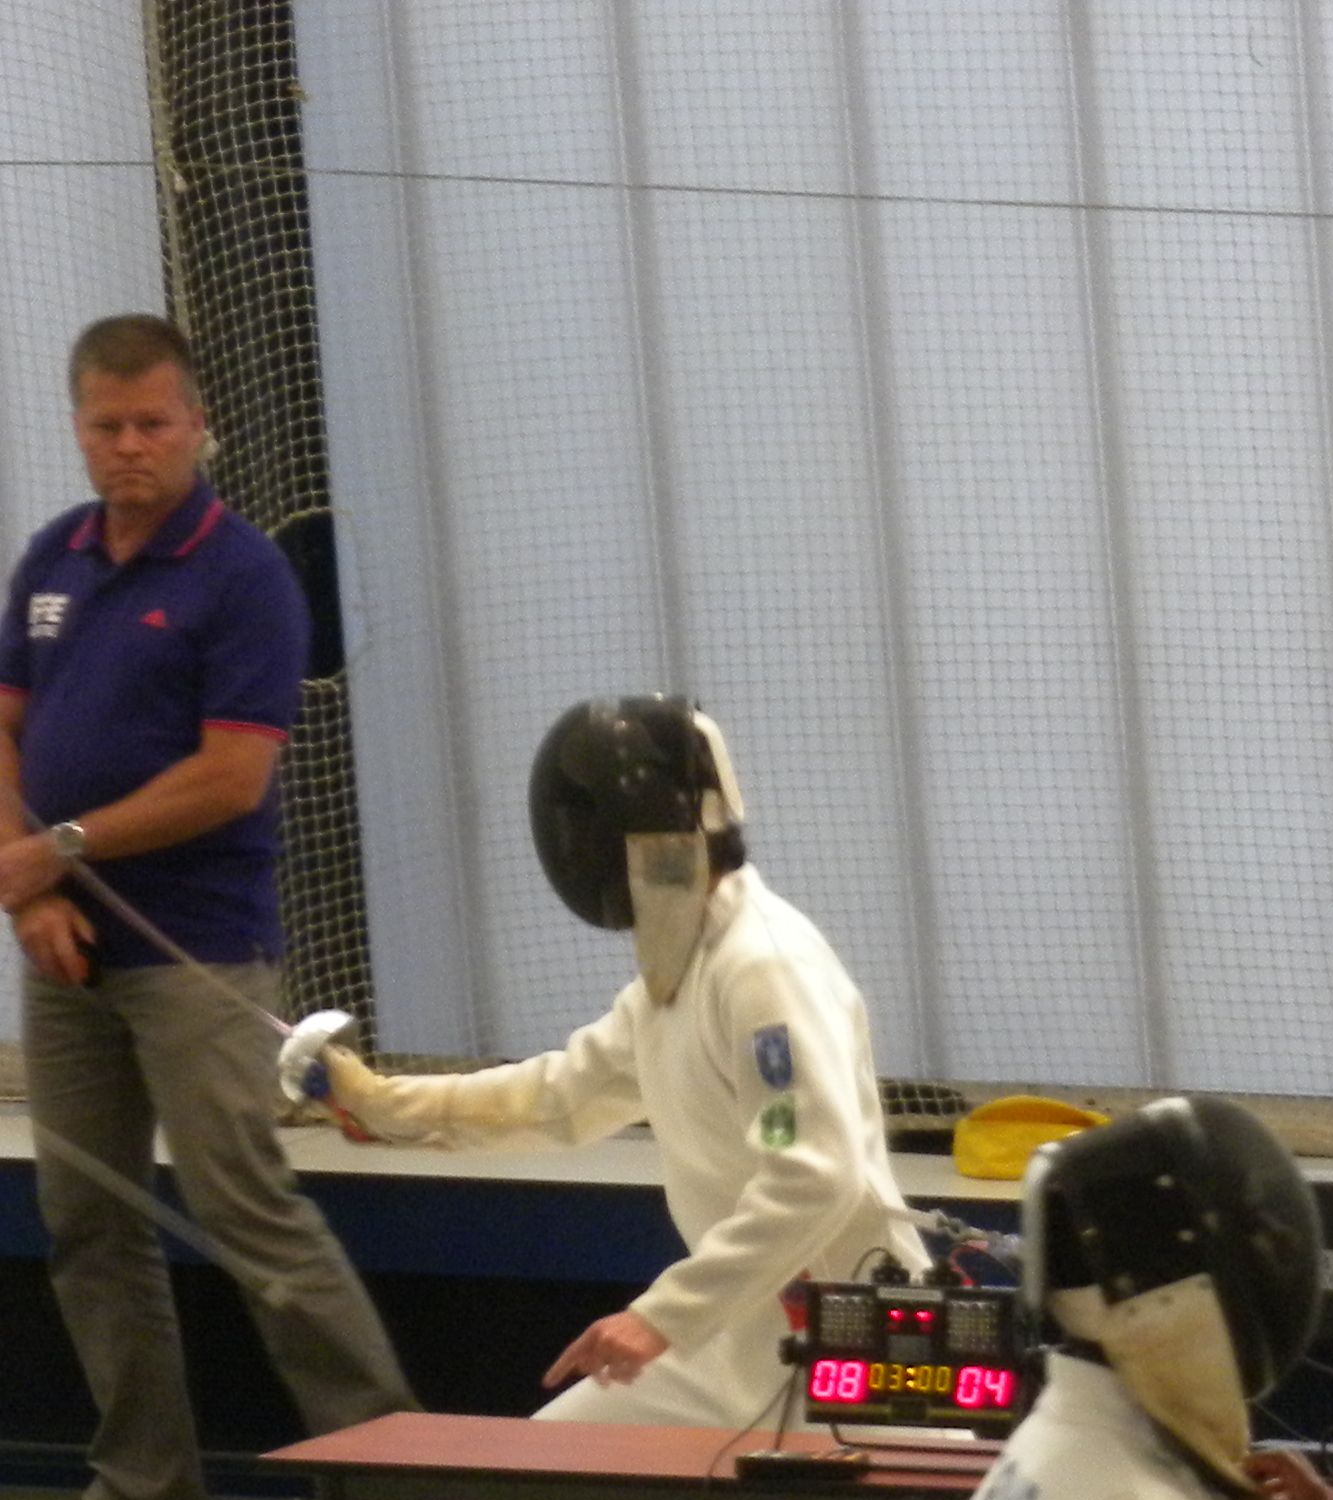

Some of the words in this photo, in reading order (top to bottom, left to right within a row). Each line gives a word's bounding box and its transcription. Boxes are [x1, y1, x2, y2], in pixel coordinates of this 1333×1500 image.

[811, 1360, 866, 1402] 08
[868, 1363, 951, 1393] 03:00
[956, 1367, 1012, 1406] 04
